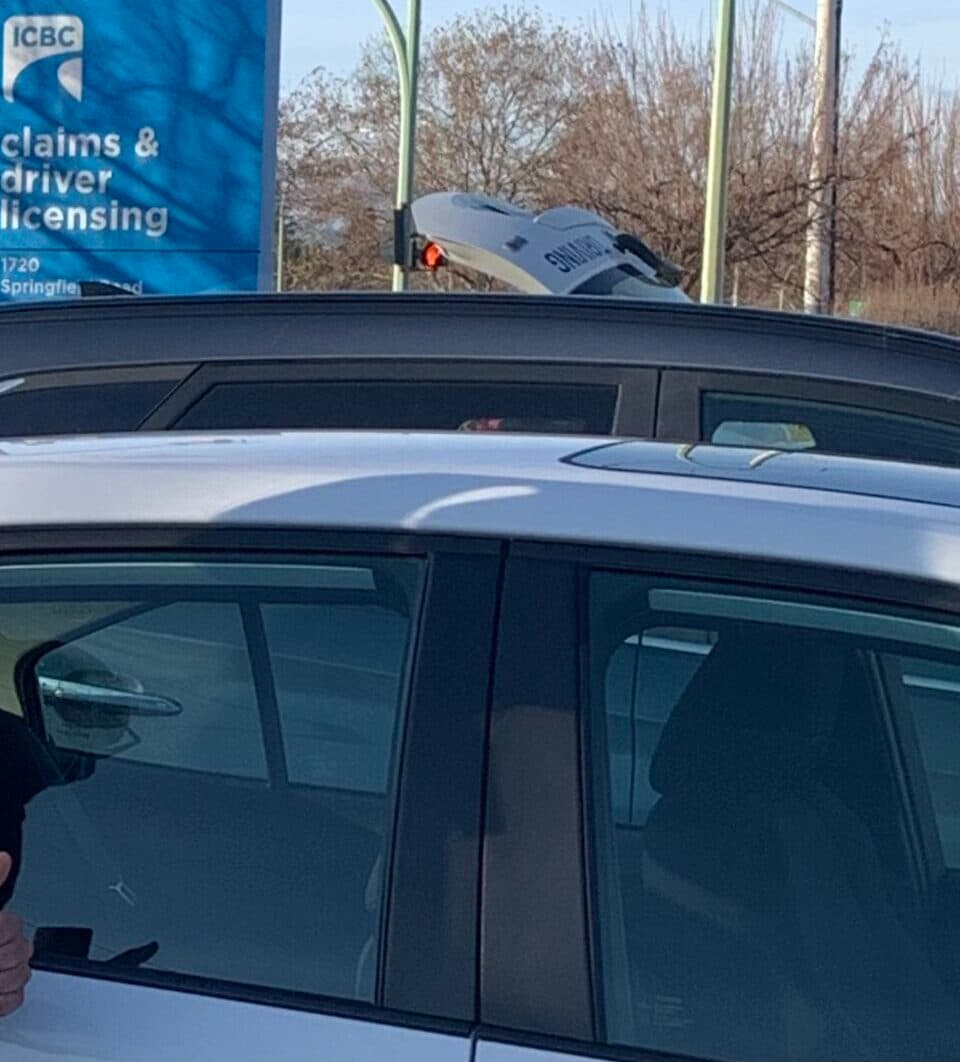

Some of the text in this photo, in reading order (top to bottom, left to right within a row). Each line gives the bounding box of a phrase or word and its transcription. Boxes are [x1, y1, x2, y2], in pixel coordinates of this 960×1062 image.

[12, 26, 76, 47] ICBC
[1, 126, 159, 158] claims &
[0, 163, 113, 194] driver
[0, 199, 169, 237] licensing
[0, 257, 40, 273] 1720
[0, 279, 81, 297] Springfie
